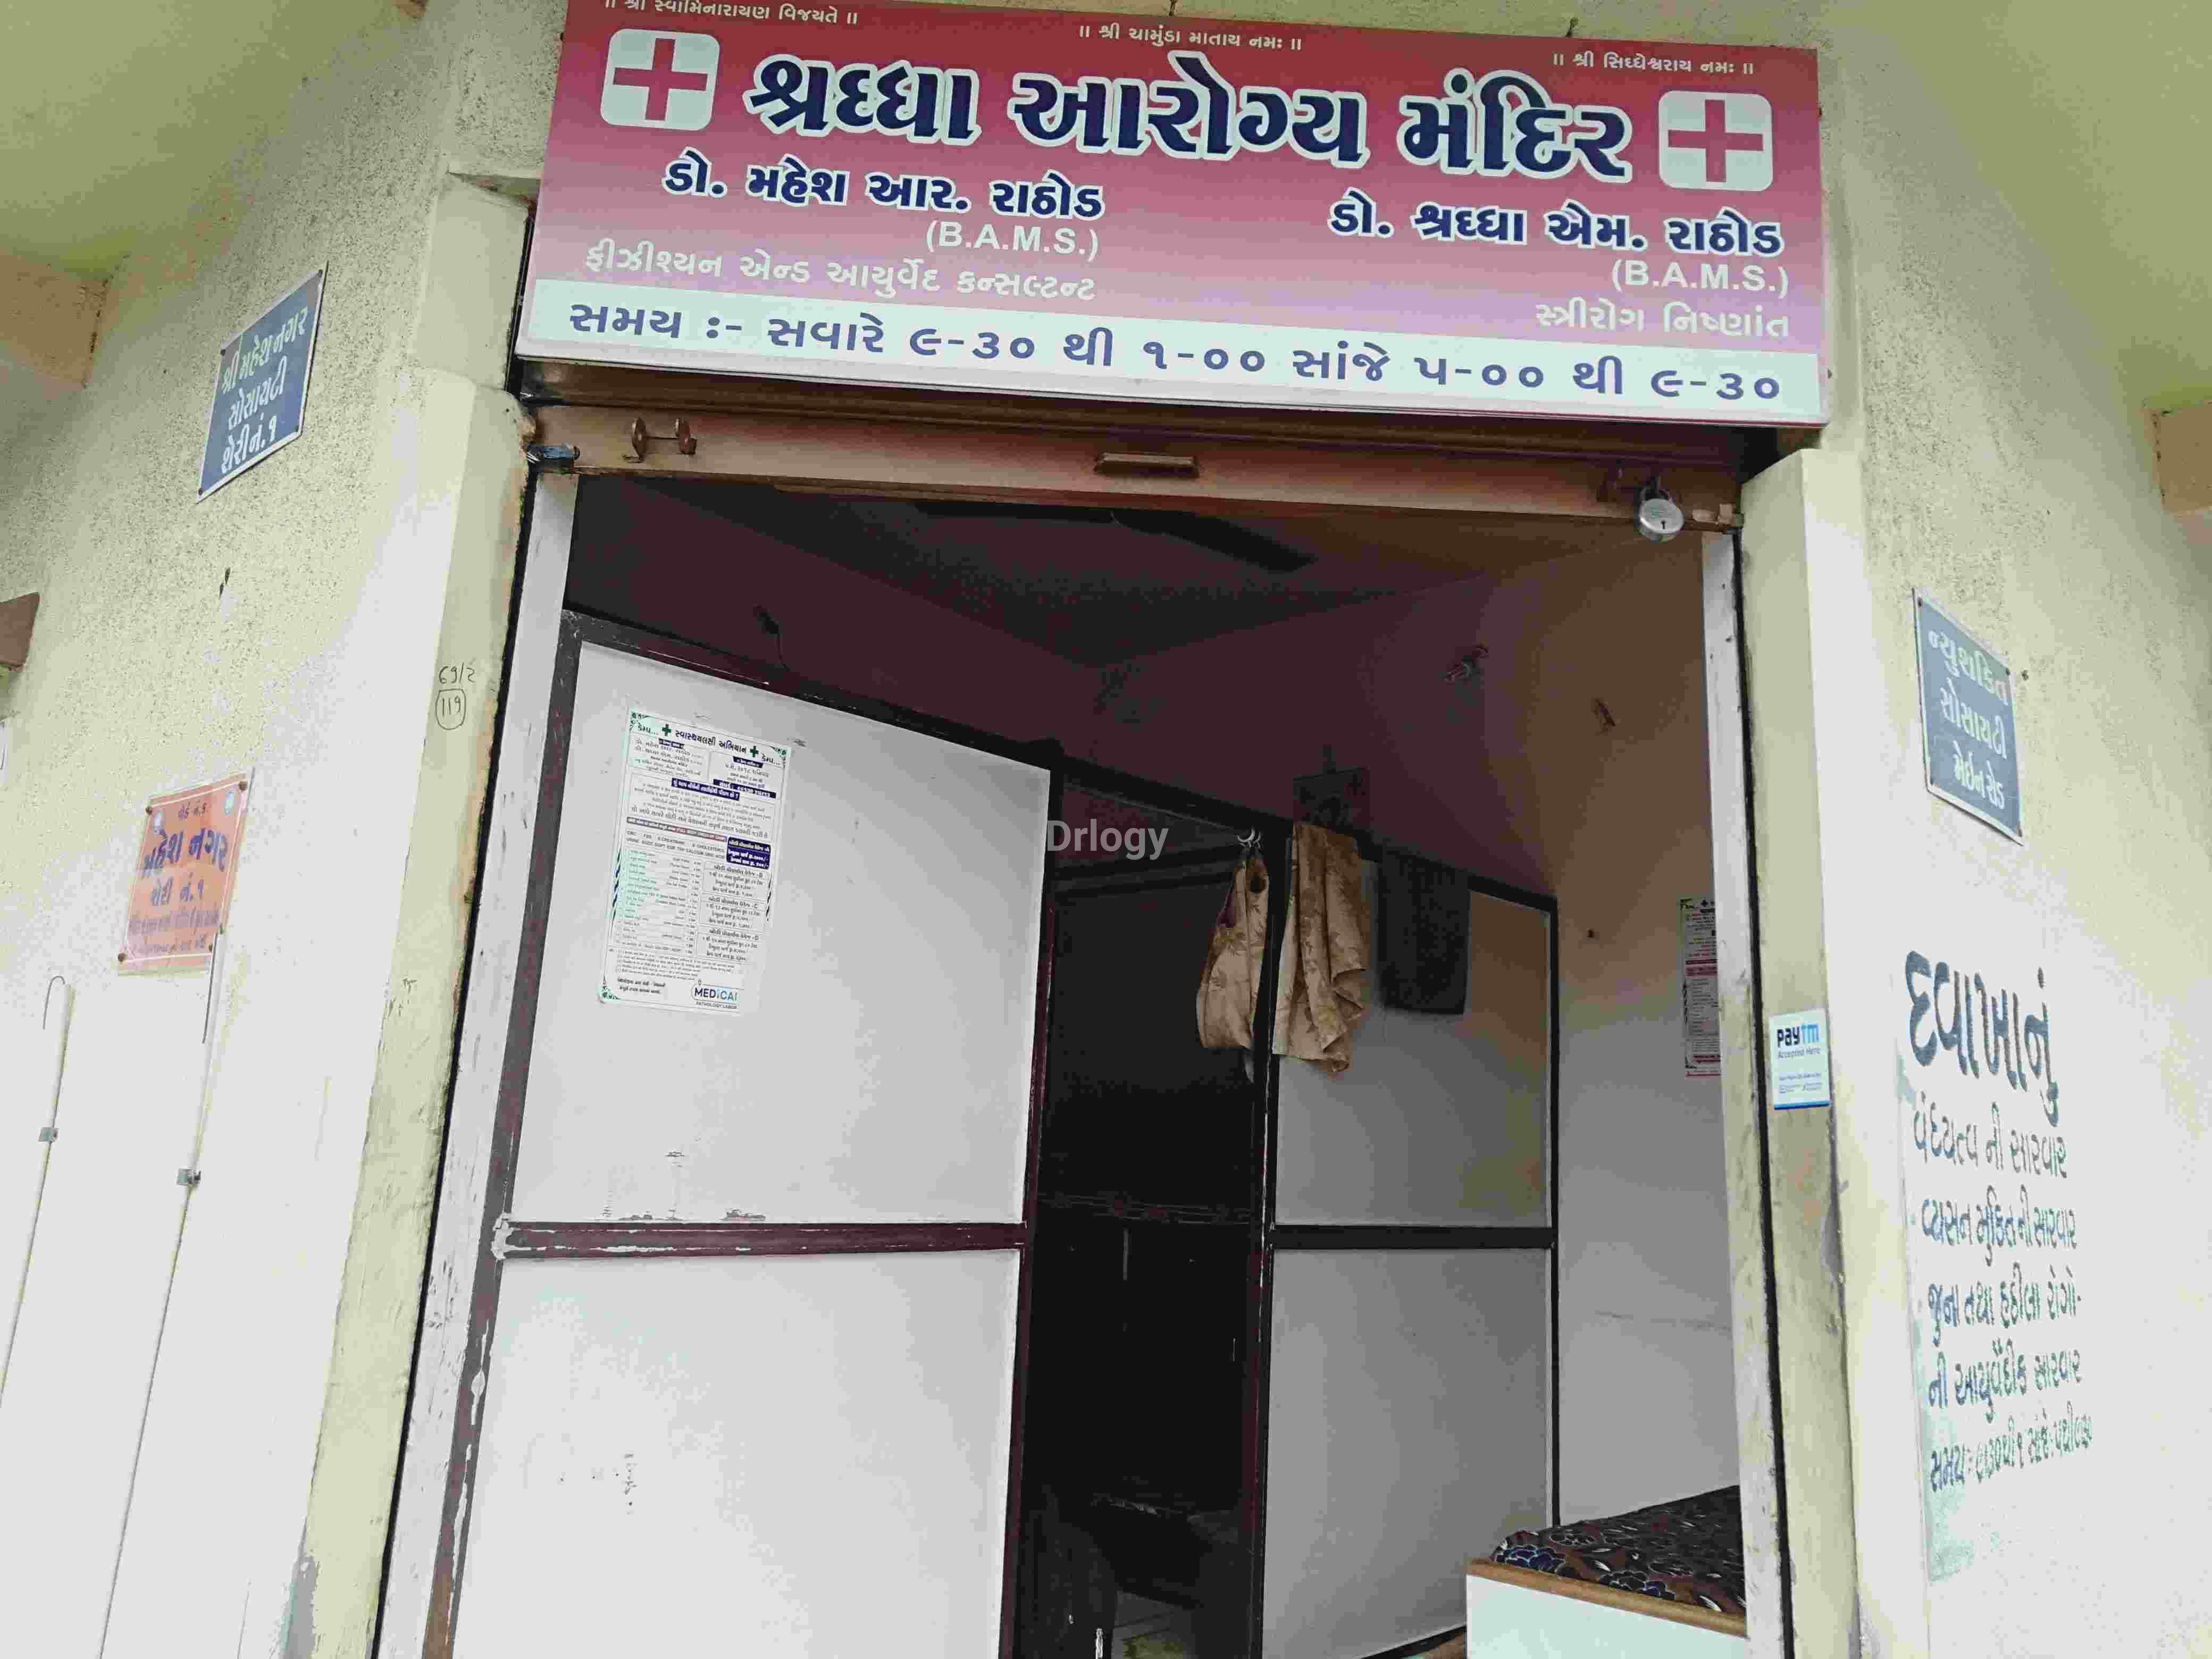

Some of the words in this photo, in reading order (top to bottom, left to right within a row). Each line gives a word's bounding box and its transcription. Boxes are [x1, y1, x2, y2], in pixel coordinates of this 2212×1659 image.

[779, 3, 837, 23] વિજયતે
[1099, 23, 1119, 39] શ્રી
[1129, 24, 1180, 46] ચામુંડા
[1189, 31, 1241, 47] માતાય
[1573, 51, 1594, 68] શ્રી
[1010, 52, 1367, 165] આરોગ્ય
[1400, 69, 1628, 181] મંદિર
[665, 148, 726, 196] ડો.
[749, 155, 848, 205] મહેશ
[867, 173, 969, 212] આર.
[992, 170, 1104, 219] રાઠોડ
[926, 220, 1097, 263] (B.A.M.S.)
[1330, 188, 1393, 236] ડો.
[1546, 200, 1645, 251] એમ.
[1667, 210, 1782, 256] રાઠોડ
[740, 247, 810, 283] એન્ડ
[826, 257, 941, 299] આયુર્વેદ
[957, 270, 1096, 300] કન્સલ્ટન્ટ
[1612, 259, 1788, 299] (B.A.M.S.)
[1535, 296, 1644, 331] સ્ત્રીરોગ
[1663, 301, 1789, 337] નિષ્ણાંત
[570, 302, 682, 340] સમય
[767, 312, 884, 354] સવારે
[909, 326, 1036, 361] ૯-૩૦
[1062, 325, 1113, 368] થી
[1141, 340, 1266, 372] ૧-૦૦
[1291, 341, 1390, 382] સાંજે
[1572, 355, 1624, 396] થી
[1650, 367, 1781, 400] ૯-૩૦
[228, 356, 288, 431] સોસાયટી
[1905, 951, 2059, 1127] દવાખાનું
[2010, 1129, 2067, 1178] સારવાર
[1965, 1281, 1994, 1325] તથા
[2034, 1350, 2082, 1390] સારવાર
